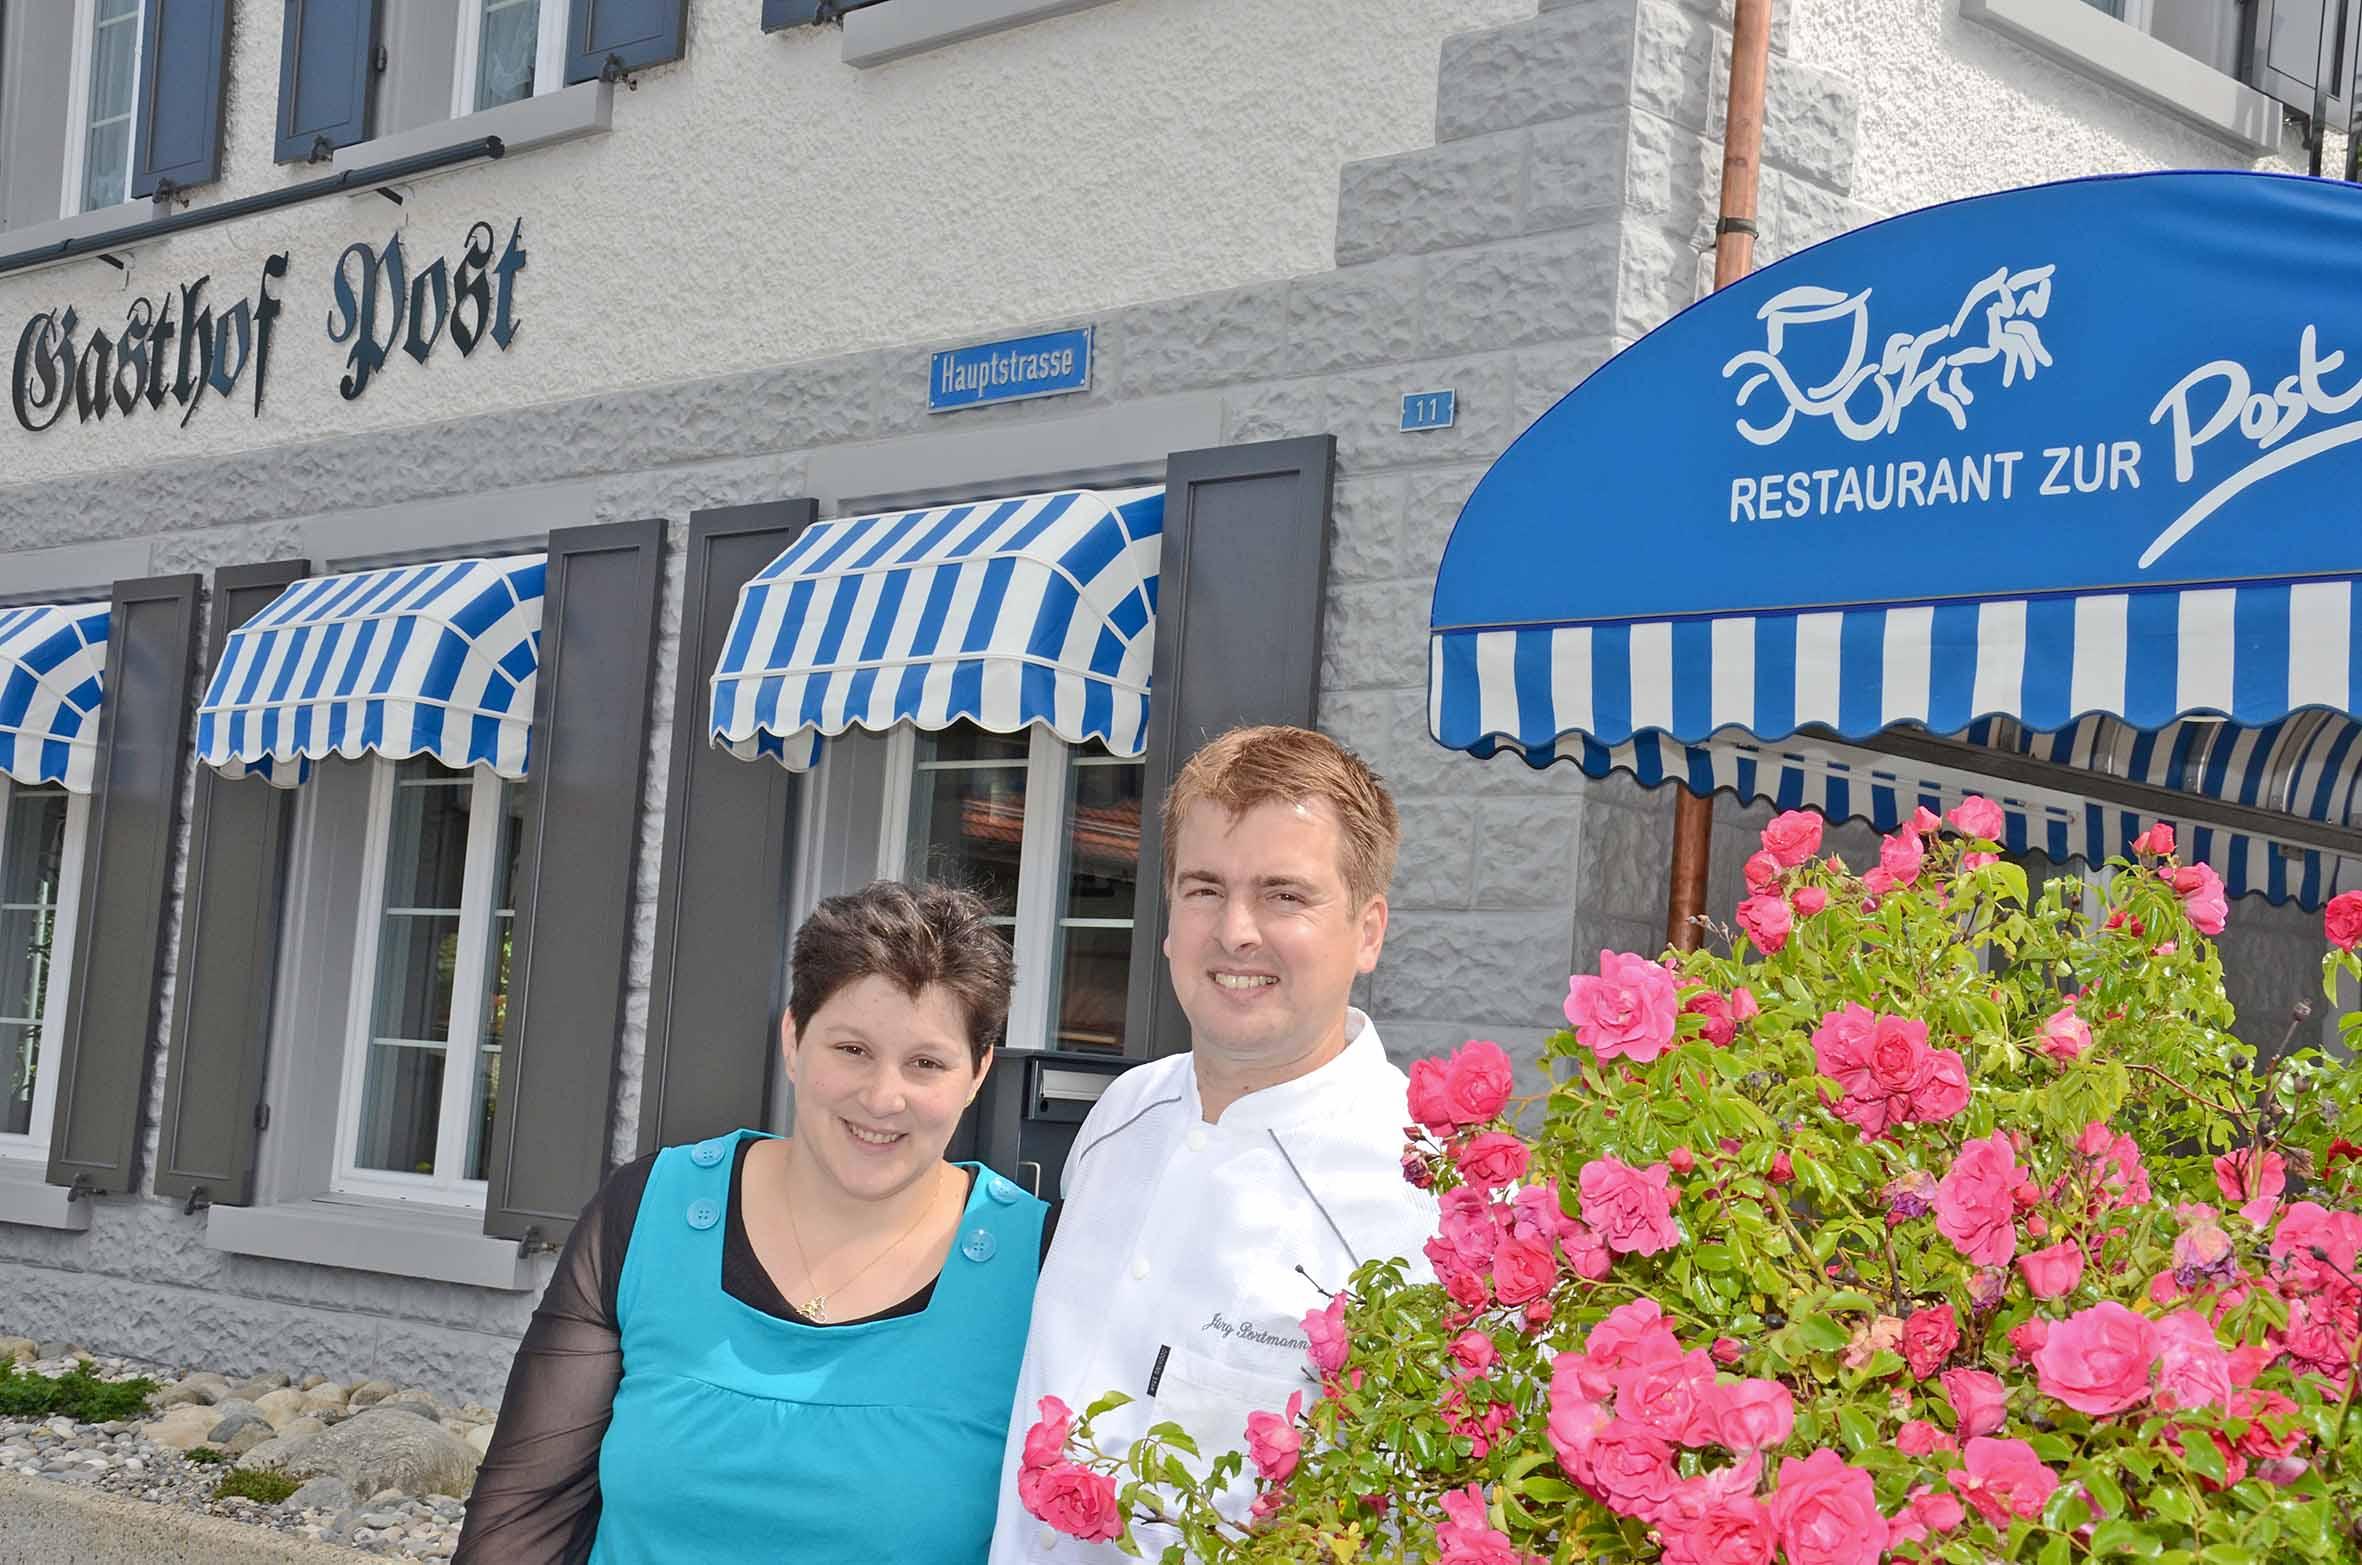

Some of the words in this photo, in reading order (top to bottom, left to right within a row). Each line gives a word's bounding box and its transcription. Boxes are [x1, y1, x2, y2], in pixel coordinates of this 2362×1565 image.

[12, 250, 289, 432] Gasthof
[327, 216, 527, 401] Post
[942, 349, 1073, 398] Hauptstrasse
[1416, 398, 1438, 423] 11
[1730, 451, 2023, 522] RESTAURANT
[2040, 441, 2141, 496] ZUR
[2150, 324, 2362, 482] Post
